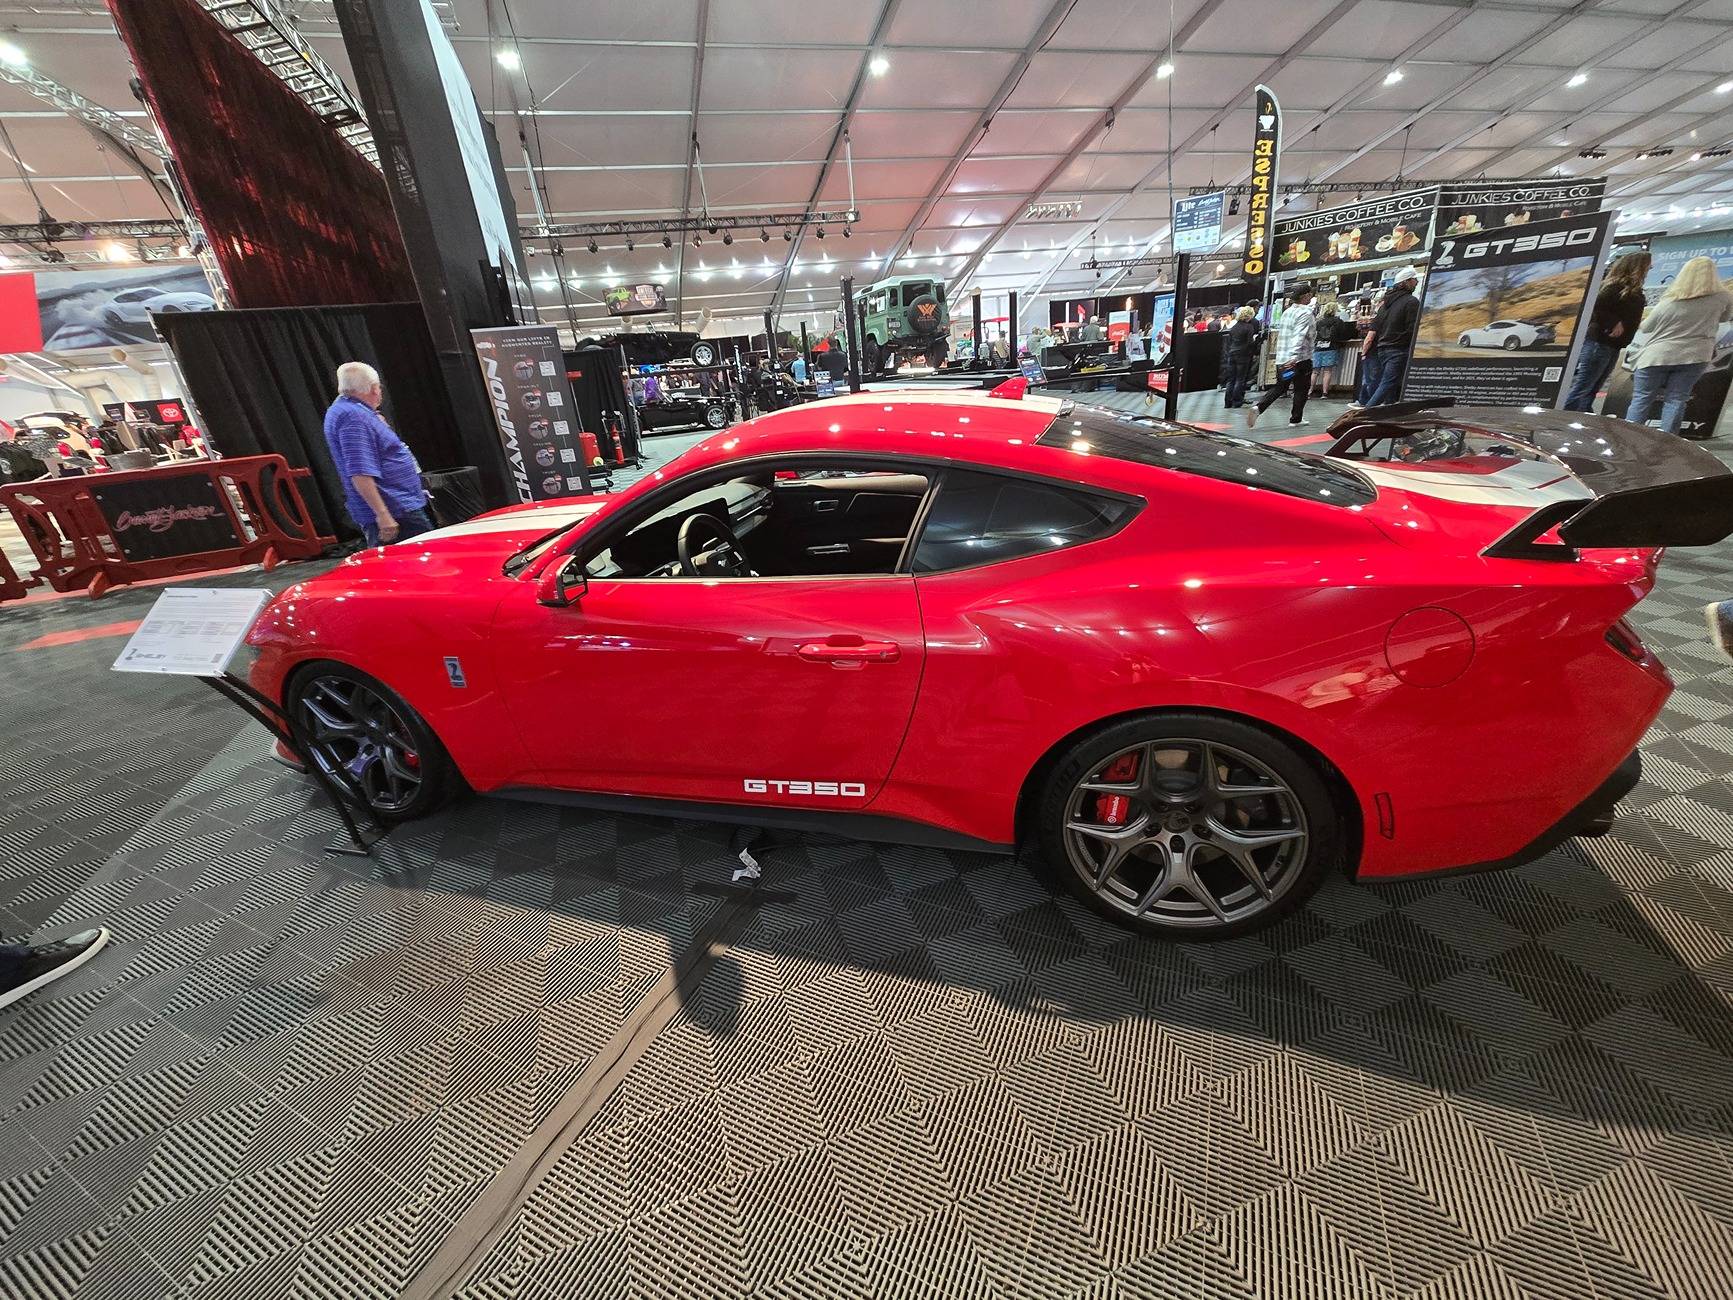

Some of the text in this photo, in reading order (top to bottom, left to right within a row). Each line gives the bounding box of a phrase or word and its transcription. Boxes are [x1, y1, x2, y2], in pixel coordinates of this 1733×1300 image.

[1451, 186, 1591, 206] JUNKIES COFFEE CO.
[1281, 196, 1427, 233] JUNKIES COFFEE CO.
[1463, 227, 1598, 259] GT350
[1659, 250, 1687, 260] SIGN
[1689, 248, 1708, 259] UP
[1710, 246, 1728, 256] TO
[482, 357, 534, 504] CHAMPION
[743, 779, 866, 797] GT350
